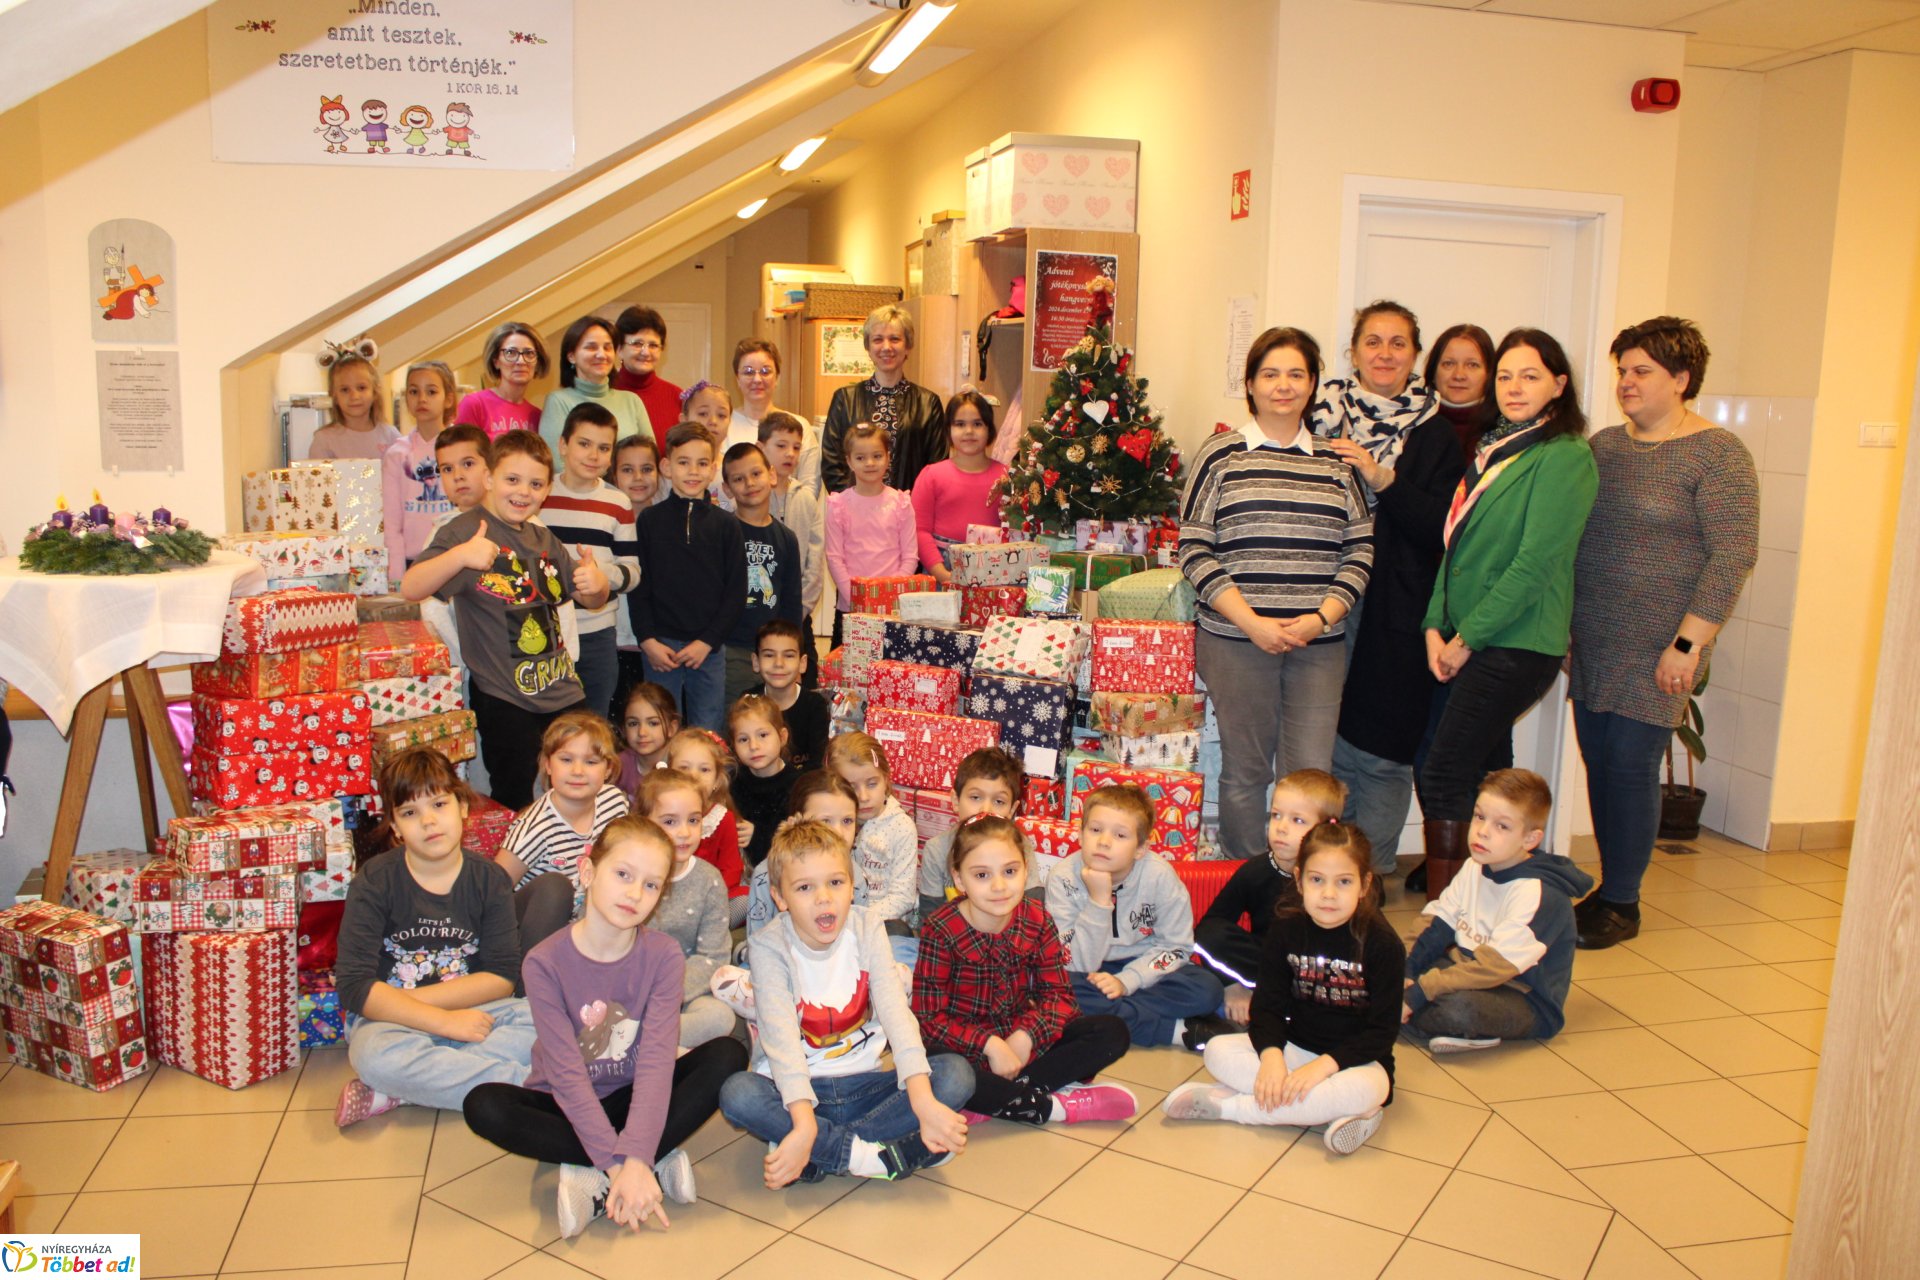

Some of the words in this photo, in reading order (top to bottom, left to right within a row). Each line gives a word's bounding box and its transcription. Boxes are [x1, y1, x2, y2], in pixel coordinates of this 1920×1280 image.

[327, 25, 375, 42] amit
[278, 52, 402, 72] szeretetben
[407, 55, 516, 78] történjék.”
[447, 82, 453, 93] 1
[455, 83, 483, 94] KOR
[505, 84, 519, 95] 14
[1044, 266, 1074, 276] Adventi
[744, 541, 775, 556] EVEL
[514, 650, 578, 696] GRIN
[418, 917, 438, 926] LET'S
[390, 926, 474, 943] COLOURFUL
